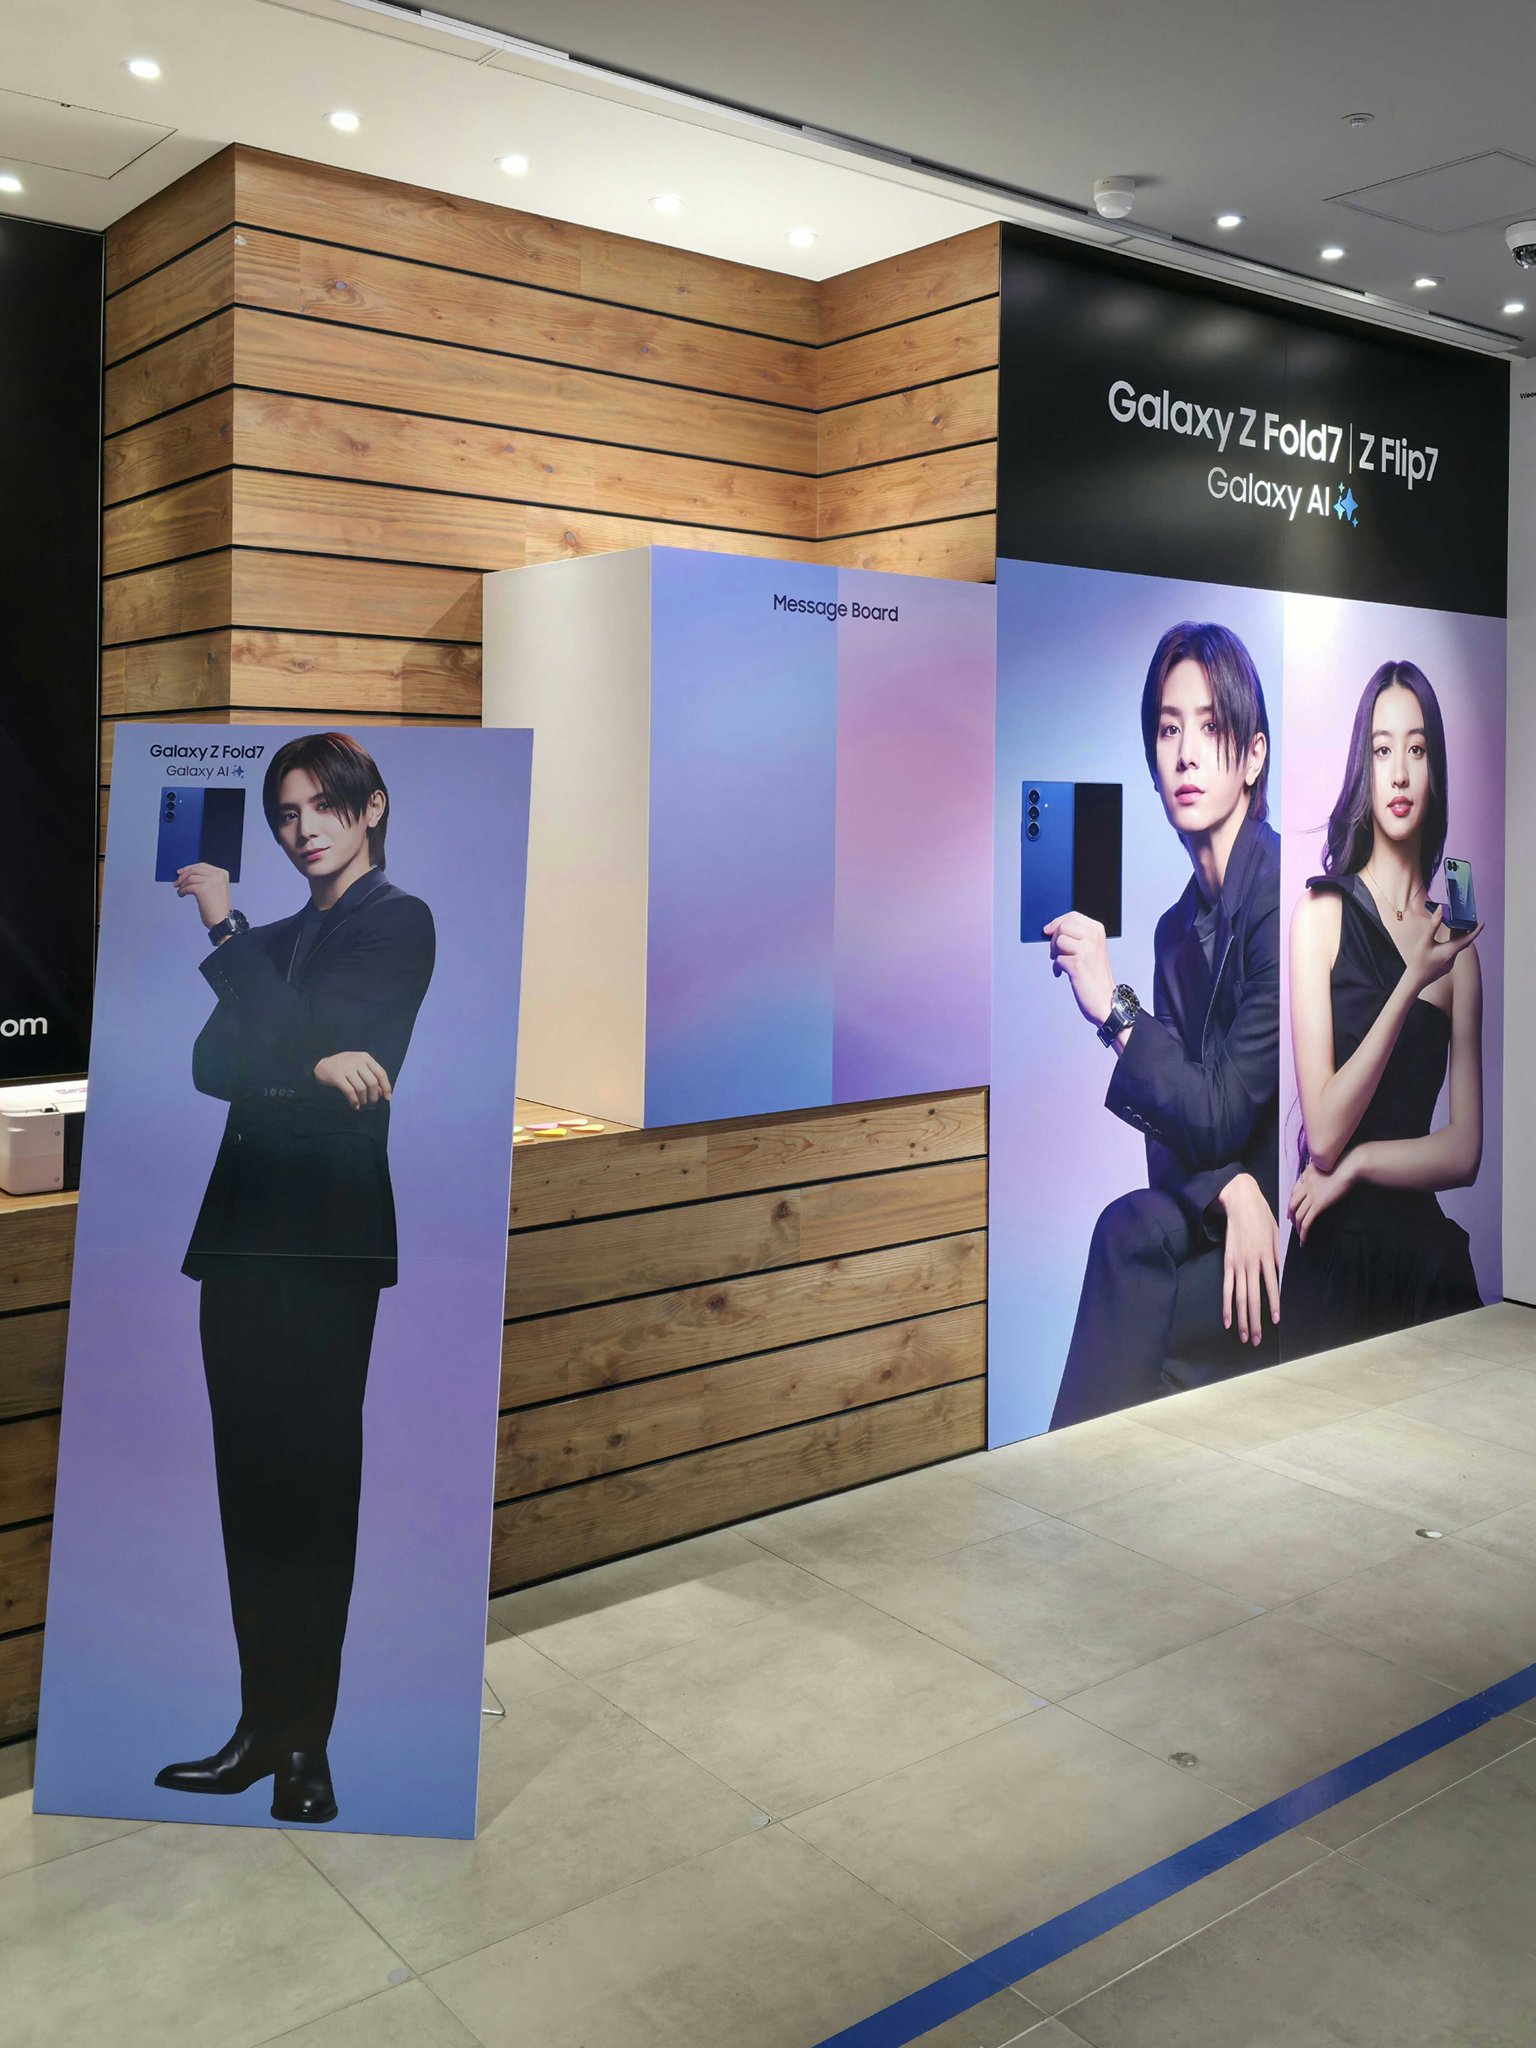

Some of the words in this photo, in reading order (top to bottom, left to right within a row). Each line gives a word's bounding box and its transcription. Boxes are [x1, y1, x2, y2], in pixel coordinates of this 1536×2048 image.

[1108, 380, 1234, 453] Galaxy
[1239, 406, 1257, 448] Z
[1264, 412, 1343, 463] Fold7
[1359, 432, 1375, 471] Z
[1381, 437, 1439, 491] Flip7
[1207, 466, 1303, 521] Galaxy
[1307, 484, 1330, 517] AI
[773, 594, 848, 622] Message
[851, 602, 899, 622] Board
[150, 744, 208, 761] Galaxy
[210, 745, 219, 759] Z
[222, 745, 265, 759] Fold7
[166, 765, 214, 780] Galaxy
[216, 766, 229, 777] AI
